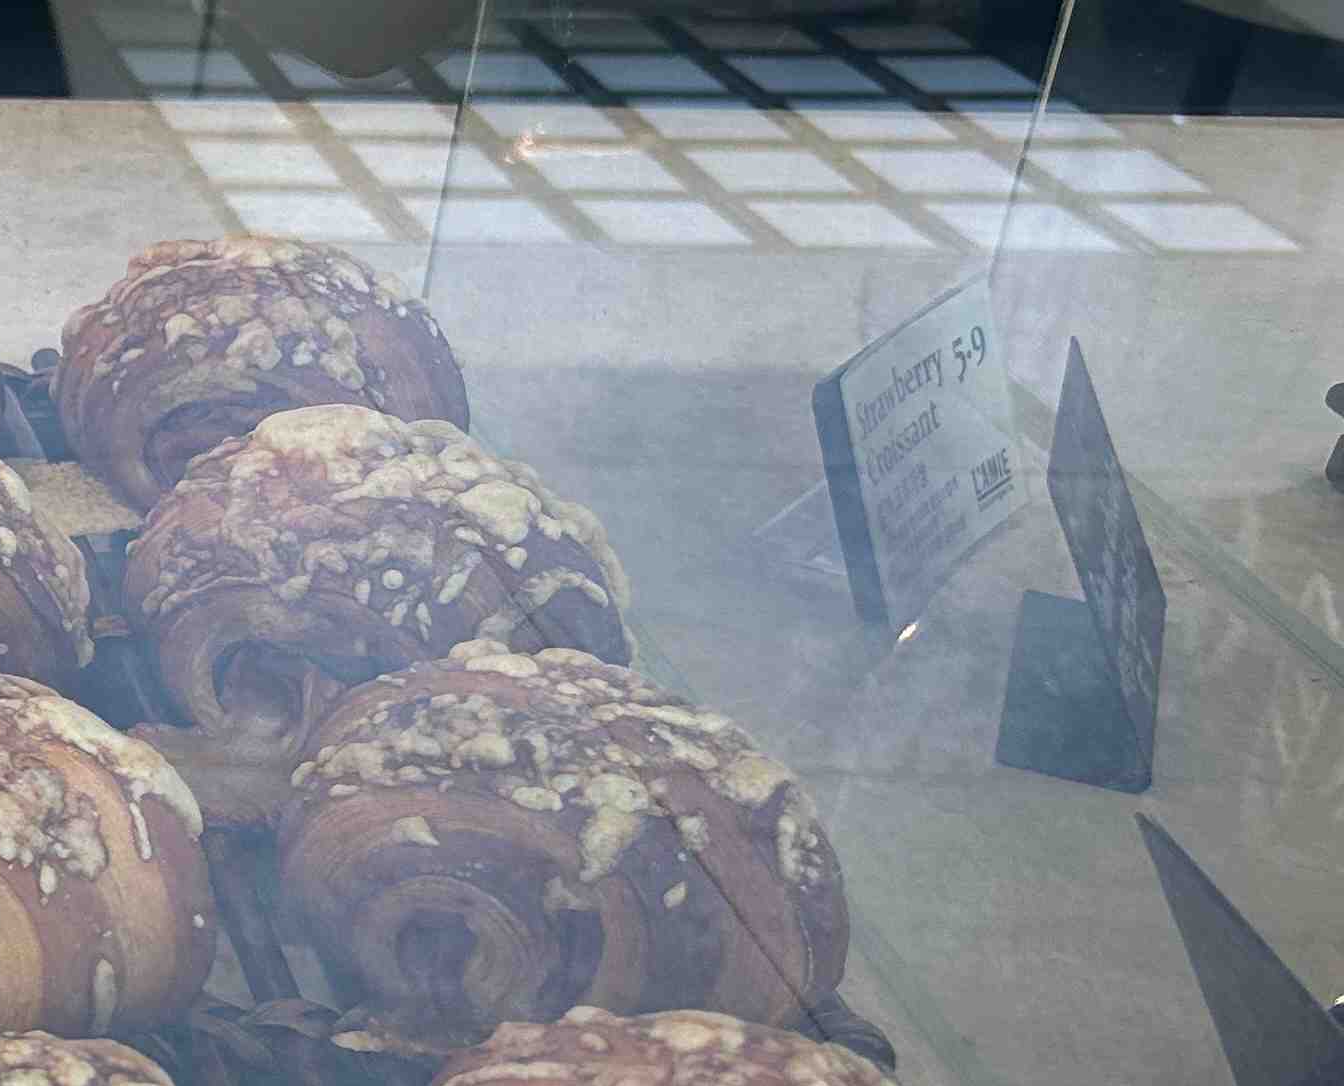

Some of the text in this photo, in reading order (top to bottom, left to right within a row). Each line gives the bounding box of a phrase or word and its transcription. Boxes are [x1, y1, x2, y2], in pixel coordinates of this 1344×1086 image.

[855, 325, 986, 440] Strawberry 5.9
[865, 400, 942, 487] Croissant
[972, 448, 1010, 497] L'AMIE
